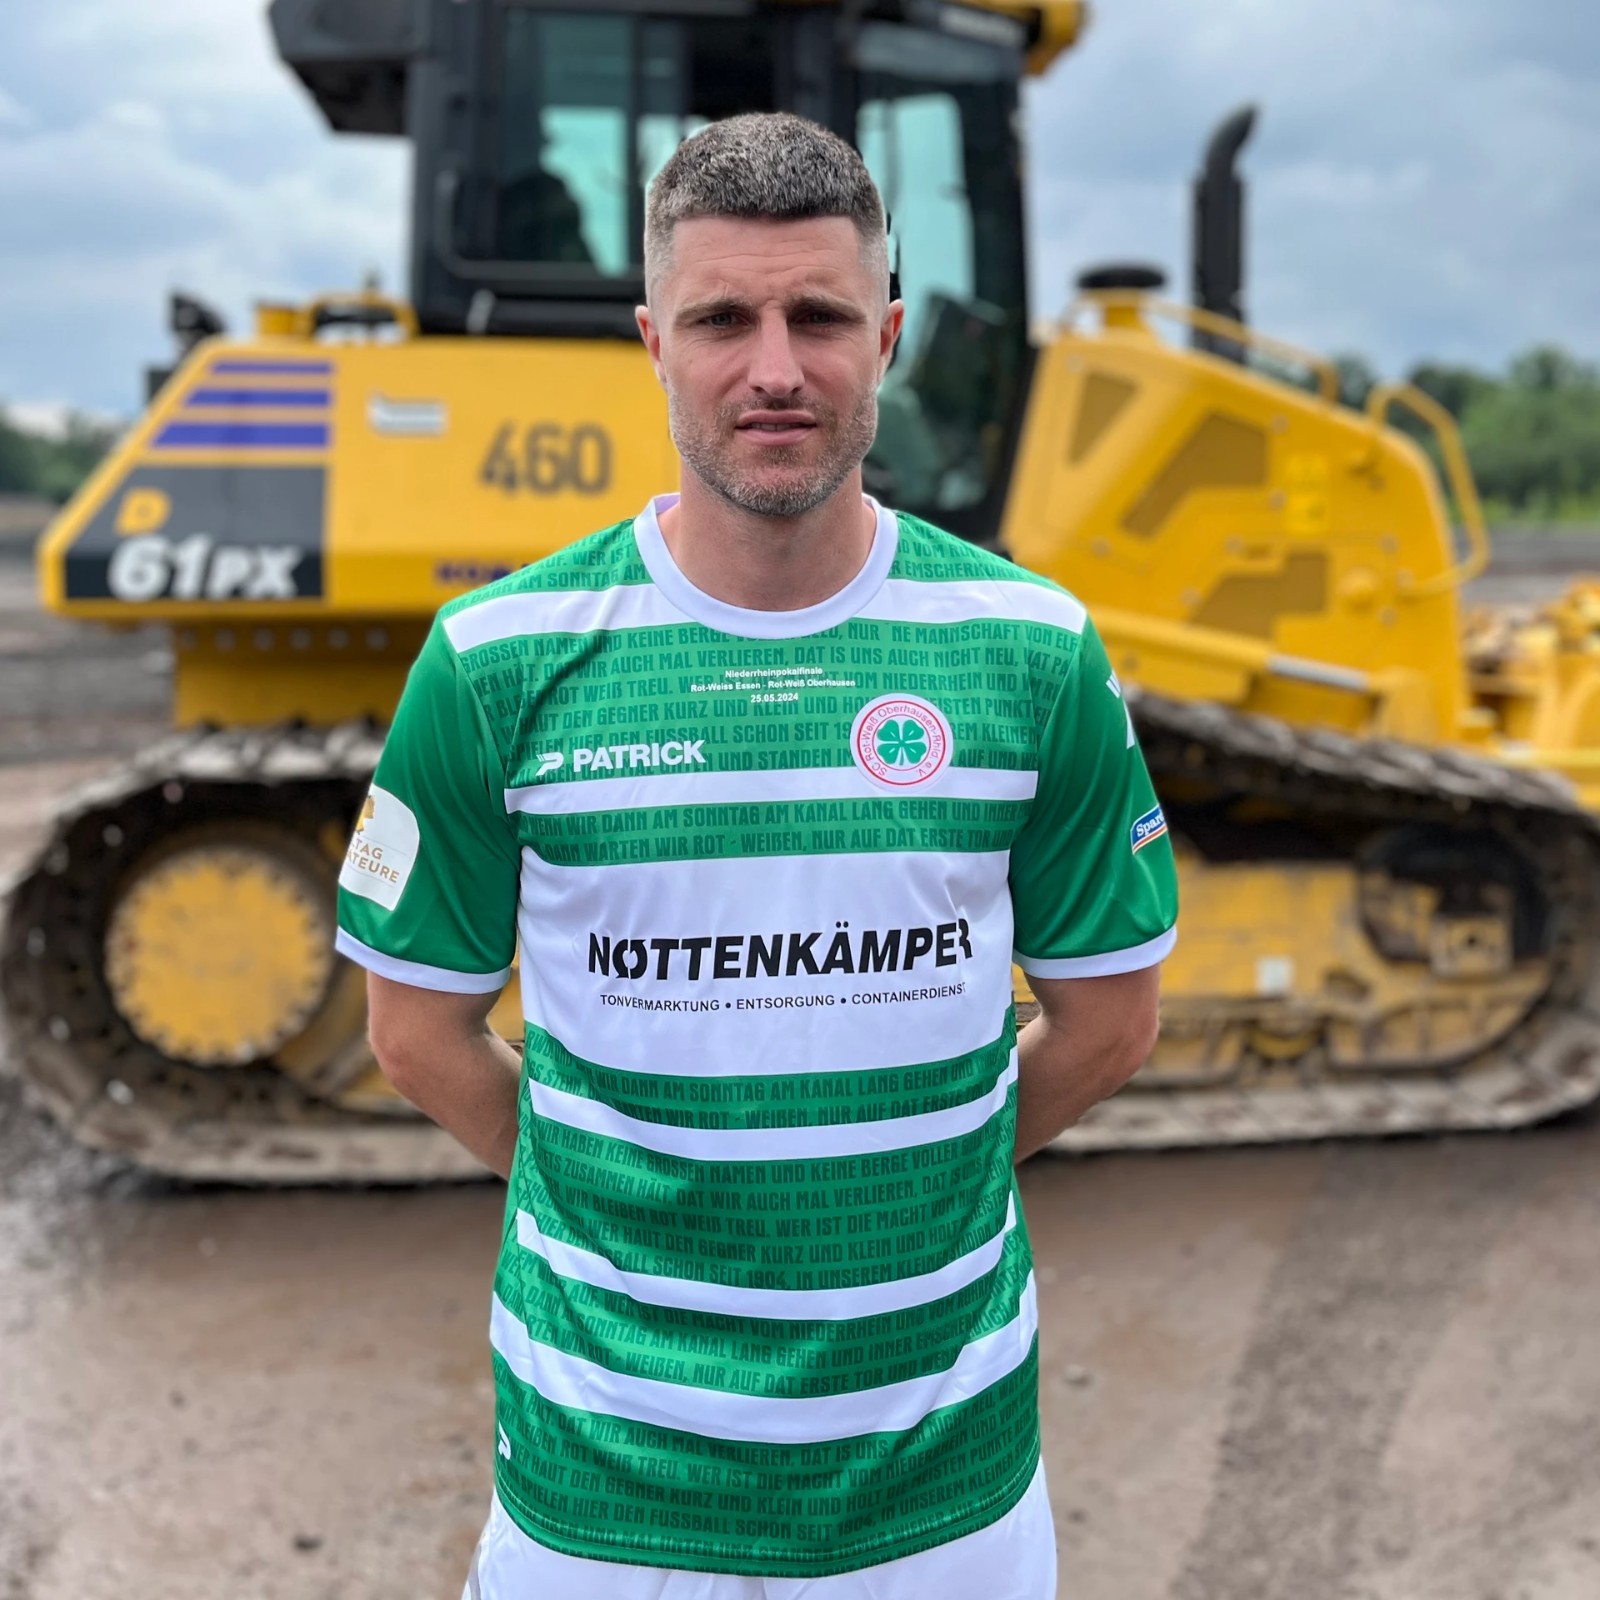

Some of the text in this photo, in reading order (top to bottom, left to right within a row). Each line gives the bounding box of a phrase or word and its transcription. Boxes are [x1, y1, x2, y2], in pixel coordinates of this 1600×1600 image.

[480, 420, 612, 495] 460
[115, 488, 171, 535] D
[573, 543, 632, 565] WER IST
[518, 570, 542, 588] AM
[547, 569, 618, 587] SONNTAG
[624, 564, 645, 580] AM
[849, 624, 1050, 644] NUR MANNSCHAFT VON
[461, 630, 673, 673] GROSSEN KEINE
[611, 647, 980, 674] AUCH MAL VERLIEREN, DAT IS UNS AUCH NICHT
[627, 677, 673, 697] TREU.
[883, 672, 982, 691] NIEDERRHEIN
[987, 673, 1017, 691] UND
[691, 679, 855, 692] Rot-Weiss Essen Rot-Weiß Oberhausen
[725, 667, 822, 678] Niederrheinpokalfinale
[562, 696, 837, 729] DEN GEGNER KURZ UND UND
[750, 693, 798, 703] 25.05.2024
[733, 722, 829, 744] SCHON SEIT
[573, 739, 707, 773] PATRICK
[719, 748, 831, 771] UND STANDEN
[872, 762, 887, 776] SC
[566, 800, 980, 836] WIR DANN AM SONNTAG AM KANAL LANG GEHEN UND
[585, 828, 991, 861] WARTEN WIR ROT NUR AUF DAT ERSTE TOR
[588, 918, 972, 980] NOTTENKÄMPER
[600, 982, 967, 1013] TONVERMARKTUNG ENTSORGUNG CONTAINERDIENST
[622, 1069, 947, 1102] DANN AM SONNTAG AM KANAL LANG GEHEN
[818, 1099, 919, 1126] NUR AUF DAT
[562, 1126, 604, 1150] HABEN
[606, 1143, 642, 1169] KEINE
[646, 1153, 705, 1183] GROSSEN
[710, 1165, 766, 1184] NAMEN
[771, 1164, 805, 1184] UND
[811, 1160, 857, 1181] KEINE
[861, 1153, 909, 1177] BERGE
[912, 1143, 958, 1170] VOLLER
[563, 1158, 947, 1212] ZUSAMMEN DAT WIR AUCH MAL VERLIEREN, DAT
[593, 1198, 930, 1238] BLEIBEN ROT TREU. WER IST DIE MACHT
[623, 1227, 925, 1265] HAUT DEN GEGNER KURZ UND KLEIN UND
[653, 1256, 892, 1289] SCHON SEIT IN UNSEREM
[578, 1313, 912, 1369] SONNTAG AM KANAL LANG GEHEN UND INNER
[692, 1312, 892, 1342] MACHT NIEDERRHEIN
[692, 1363, 917, 1394] NUR AUF DAT ERSTE TOR UND
[589, 1420, 888, 1466] WIR AUCH MAL DAT IS UNS
[560, 1439, 881, 1491] ROT TREU. WER IST DIE MACHT VOM
[570, 1470, 841, 1516] DEN GEGNER KURZ UND KLEIN UND
[573, 1497, 832, 1541] HIER DEN FUSSBALL SCHON SEIT
